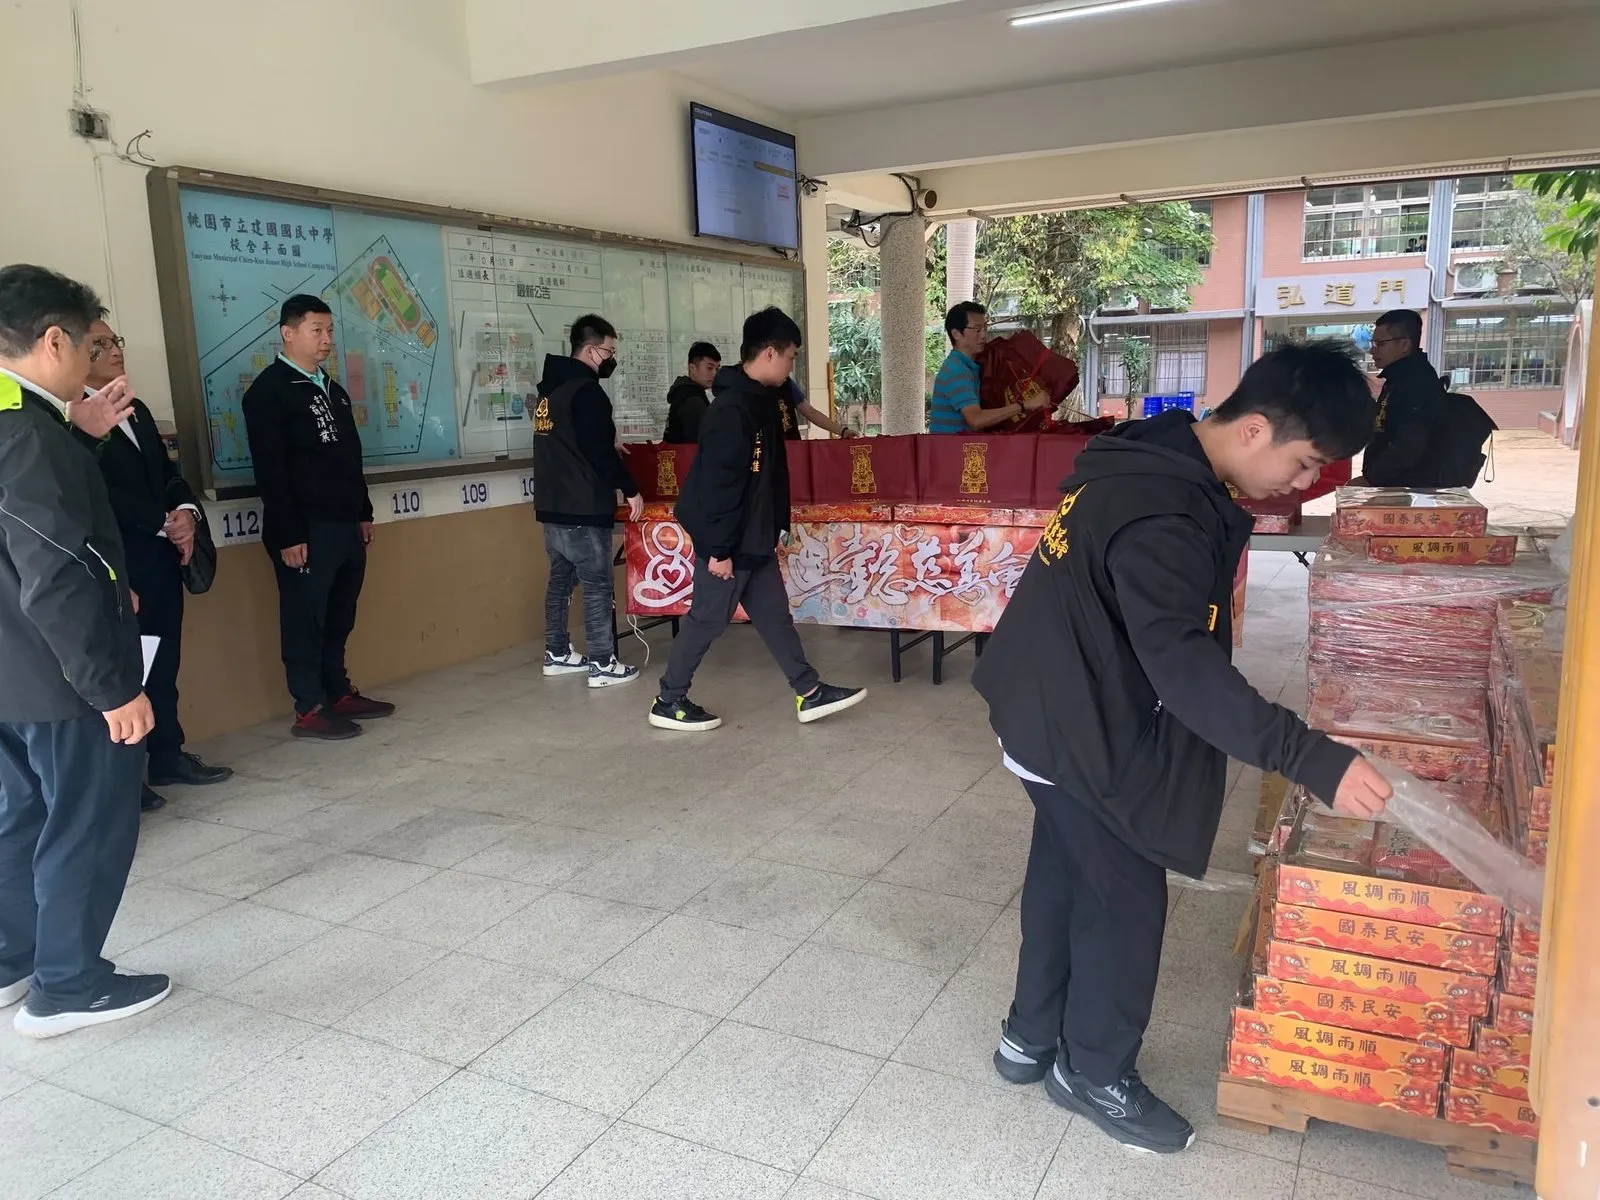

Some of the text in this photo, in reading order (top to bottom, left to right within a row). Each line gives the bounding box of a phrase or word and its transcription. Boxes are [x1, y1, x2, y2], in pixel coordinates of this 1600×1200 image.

[186, 211, 333, 245] 桃園市立建國國民中學
[229, 238, 302, 258] 校舍平面圖
[516, 283, 551, 300] 最新公告
[1277, 278, 1405, 310] 弘道門
[461, 482, 488, 505] 109
[521, 477, 535, 497] 10
[392, 491, 420, 514] 110
[222, 510, 260, 538] 112
[1383, 513, 1441, 526] 國泰民安
[1411, 541, 1471, 554] 風調雨順
[1340, 880, 1430, 907] 風調雨順
[1338, 918, 1426, 946] 國泰民安
[1329, 959, 1418, 987] 風調雨順
[1317, 992, 1403, 1020] 國泰民安
[1293, 1025, 1378, 1056] 風調雨順
[1288, 1058, 1373, 1089] 風調雨順
